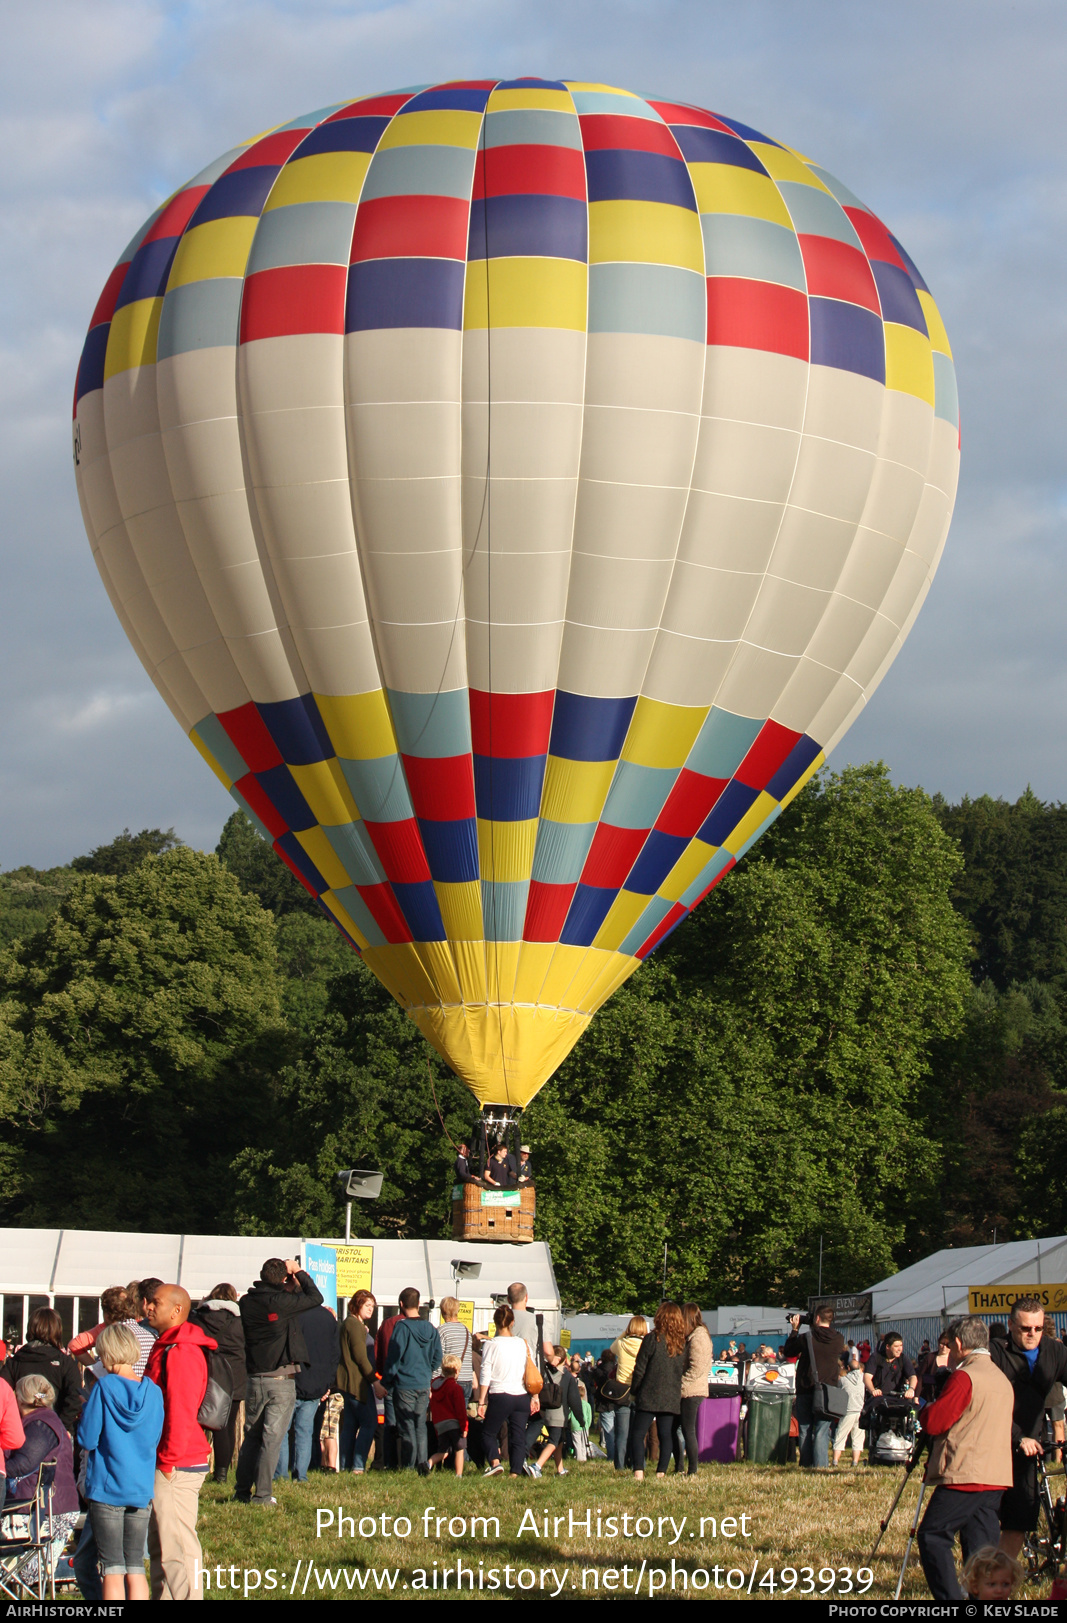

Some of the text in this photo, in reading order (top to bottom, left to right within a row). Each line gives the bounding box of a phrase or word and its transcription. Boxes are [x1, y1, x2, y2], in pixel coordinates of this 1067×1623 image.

[308, 1256, 335, 1275] Pass Holders
[336, 1256, 369, 1265] MARITANS
[315, 1273, 328, 1289] ONLY
[836, 1297, 856, 1308] EVENT
